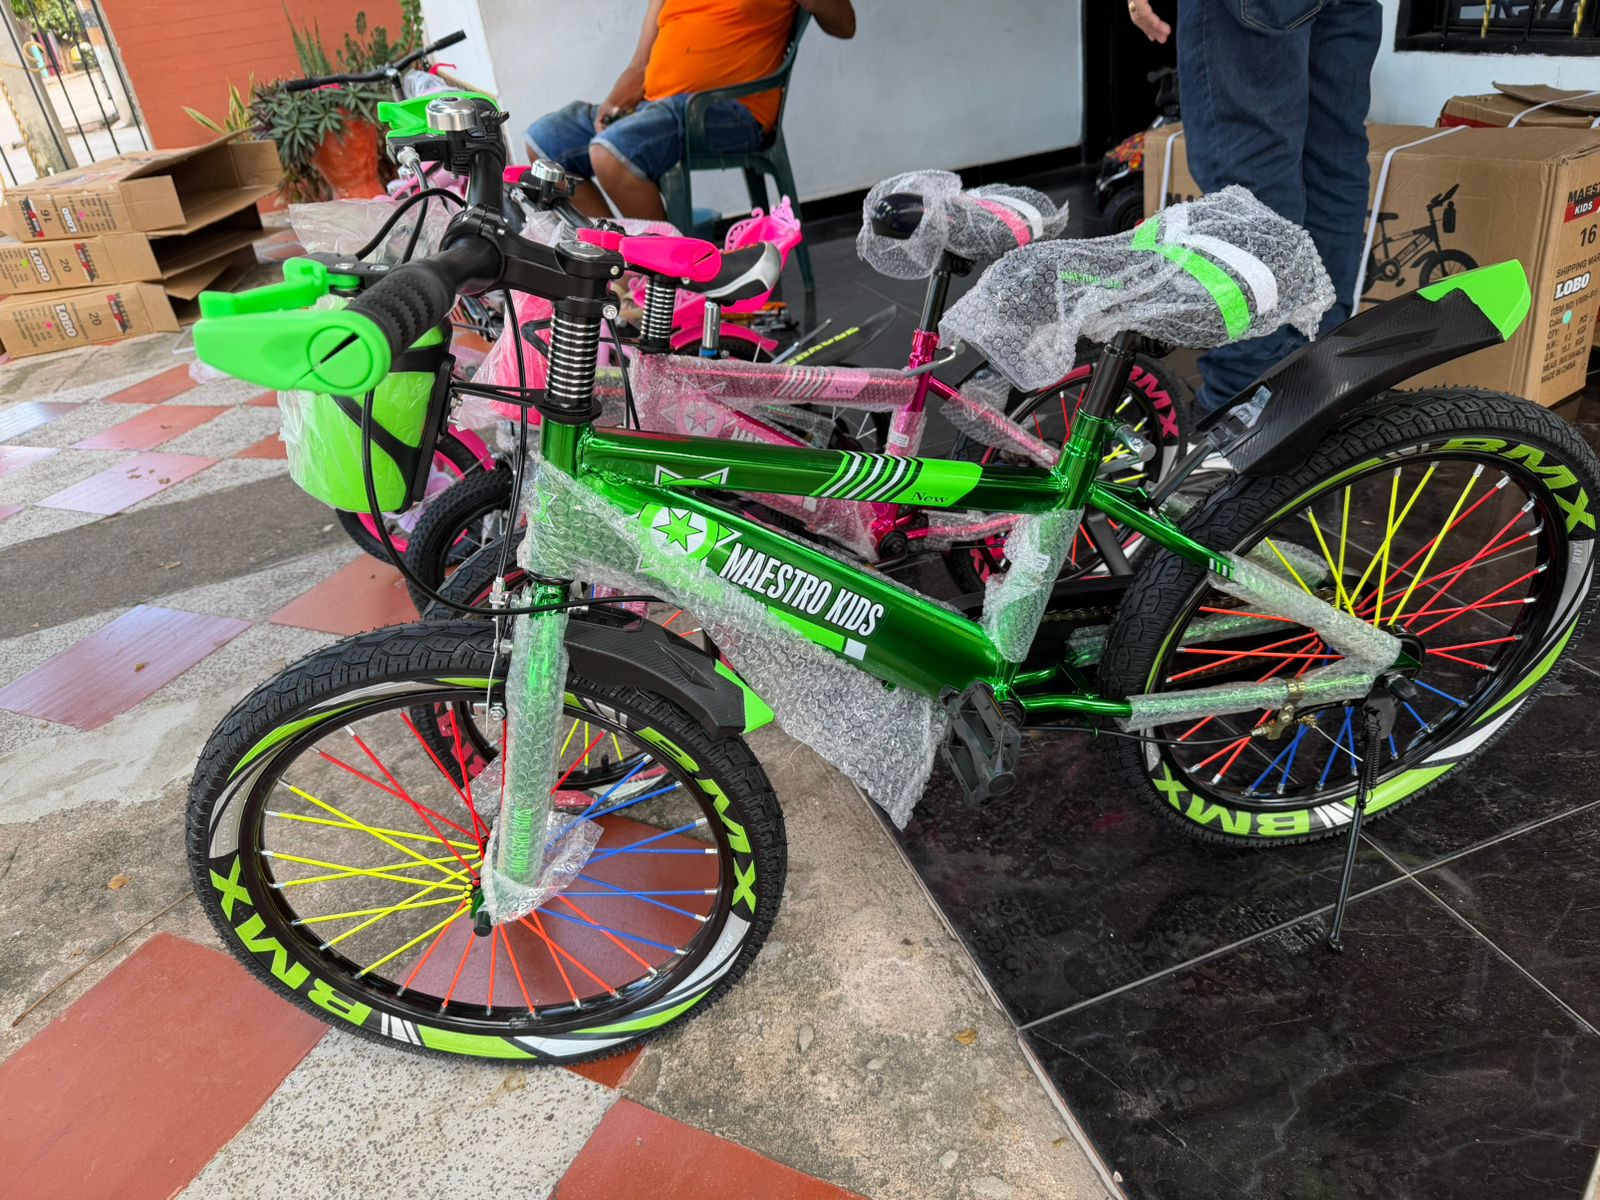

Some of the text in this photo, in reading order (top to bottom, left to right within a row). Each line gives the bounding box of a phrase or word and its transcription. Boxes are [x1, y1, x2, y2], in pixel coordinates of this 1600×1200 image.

[1568, 181, 1600, 204] MAES
[40, 209, 52, 223] 16
[61, 206, 79, 235] LOBO
[1574, 200, 1593, 215] KIDS
[1580, 224, 1597, 248] 16
[28, 247, 52, 283] LOBO
[59, 259, 72, 273] 20
[1556, 259, 1587, 278] SHIPPING
[1554, 271, 1591, 301] LOBO
[53, 302, 78, 338] LOBO
[88, 312, 102, 326] 20
[911, 491, 949, 503] New
[1440, 437, 1596, 535] BMX
[719, 542, 885, 638] MAESTRO KIDS
[1151, 761, 1311, 836] BMX
[637, 726, 756, 914] BMX
[209, 855, 376, 1028] BMX
